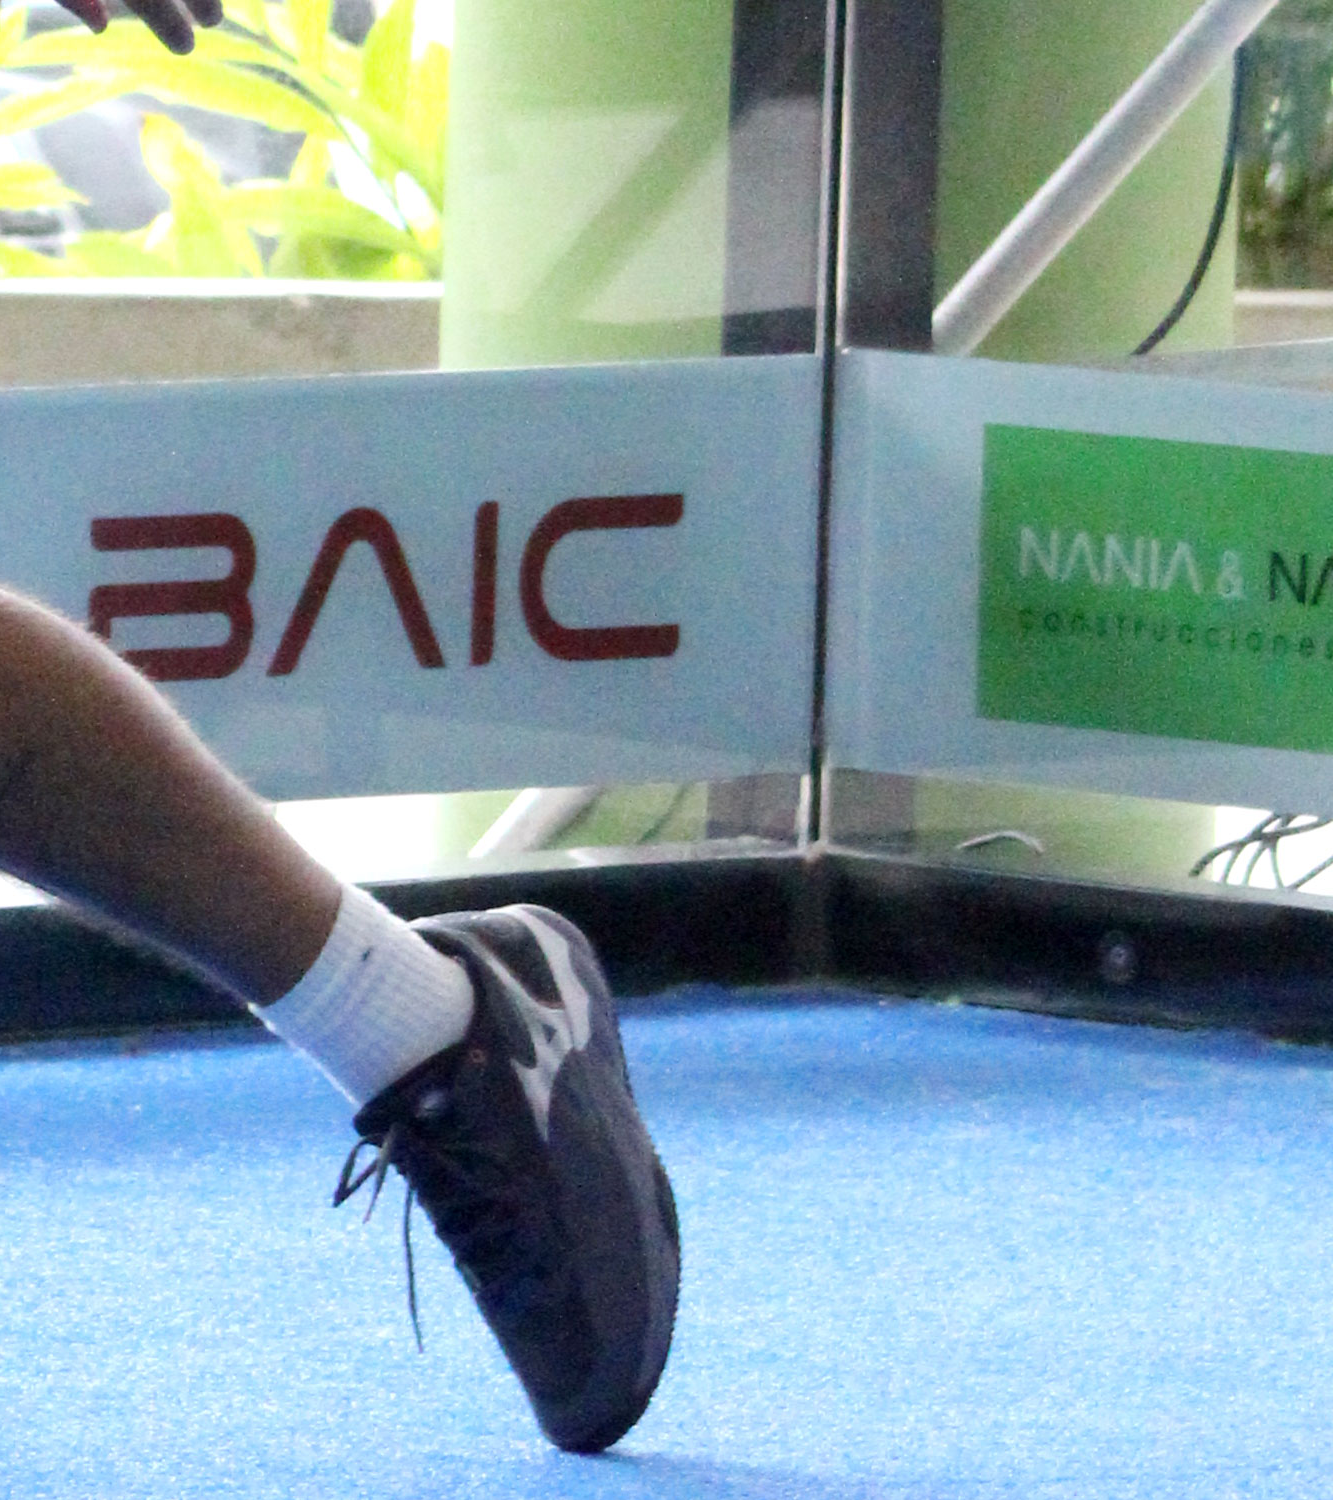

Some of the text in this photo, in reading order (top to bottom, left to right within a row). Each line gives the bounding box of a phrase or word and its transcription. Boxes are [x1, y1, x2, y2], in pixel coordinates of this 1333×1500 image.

[89, 494, 684, 681] BAIC
[1019, 526, 1202, 594] NANIA
[1217, 550, 1244, 600] &
